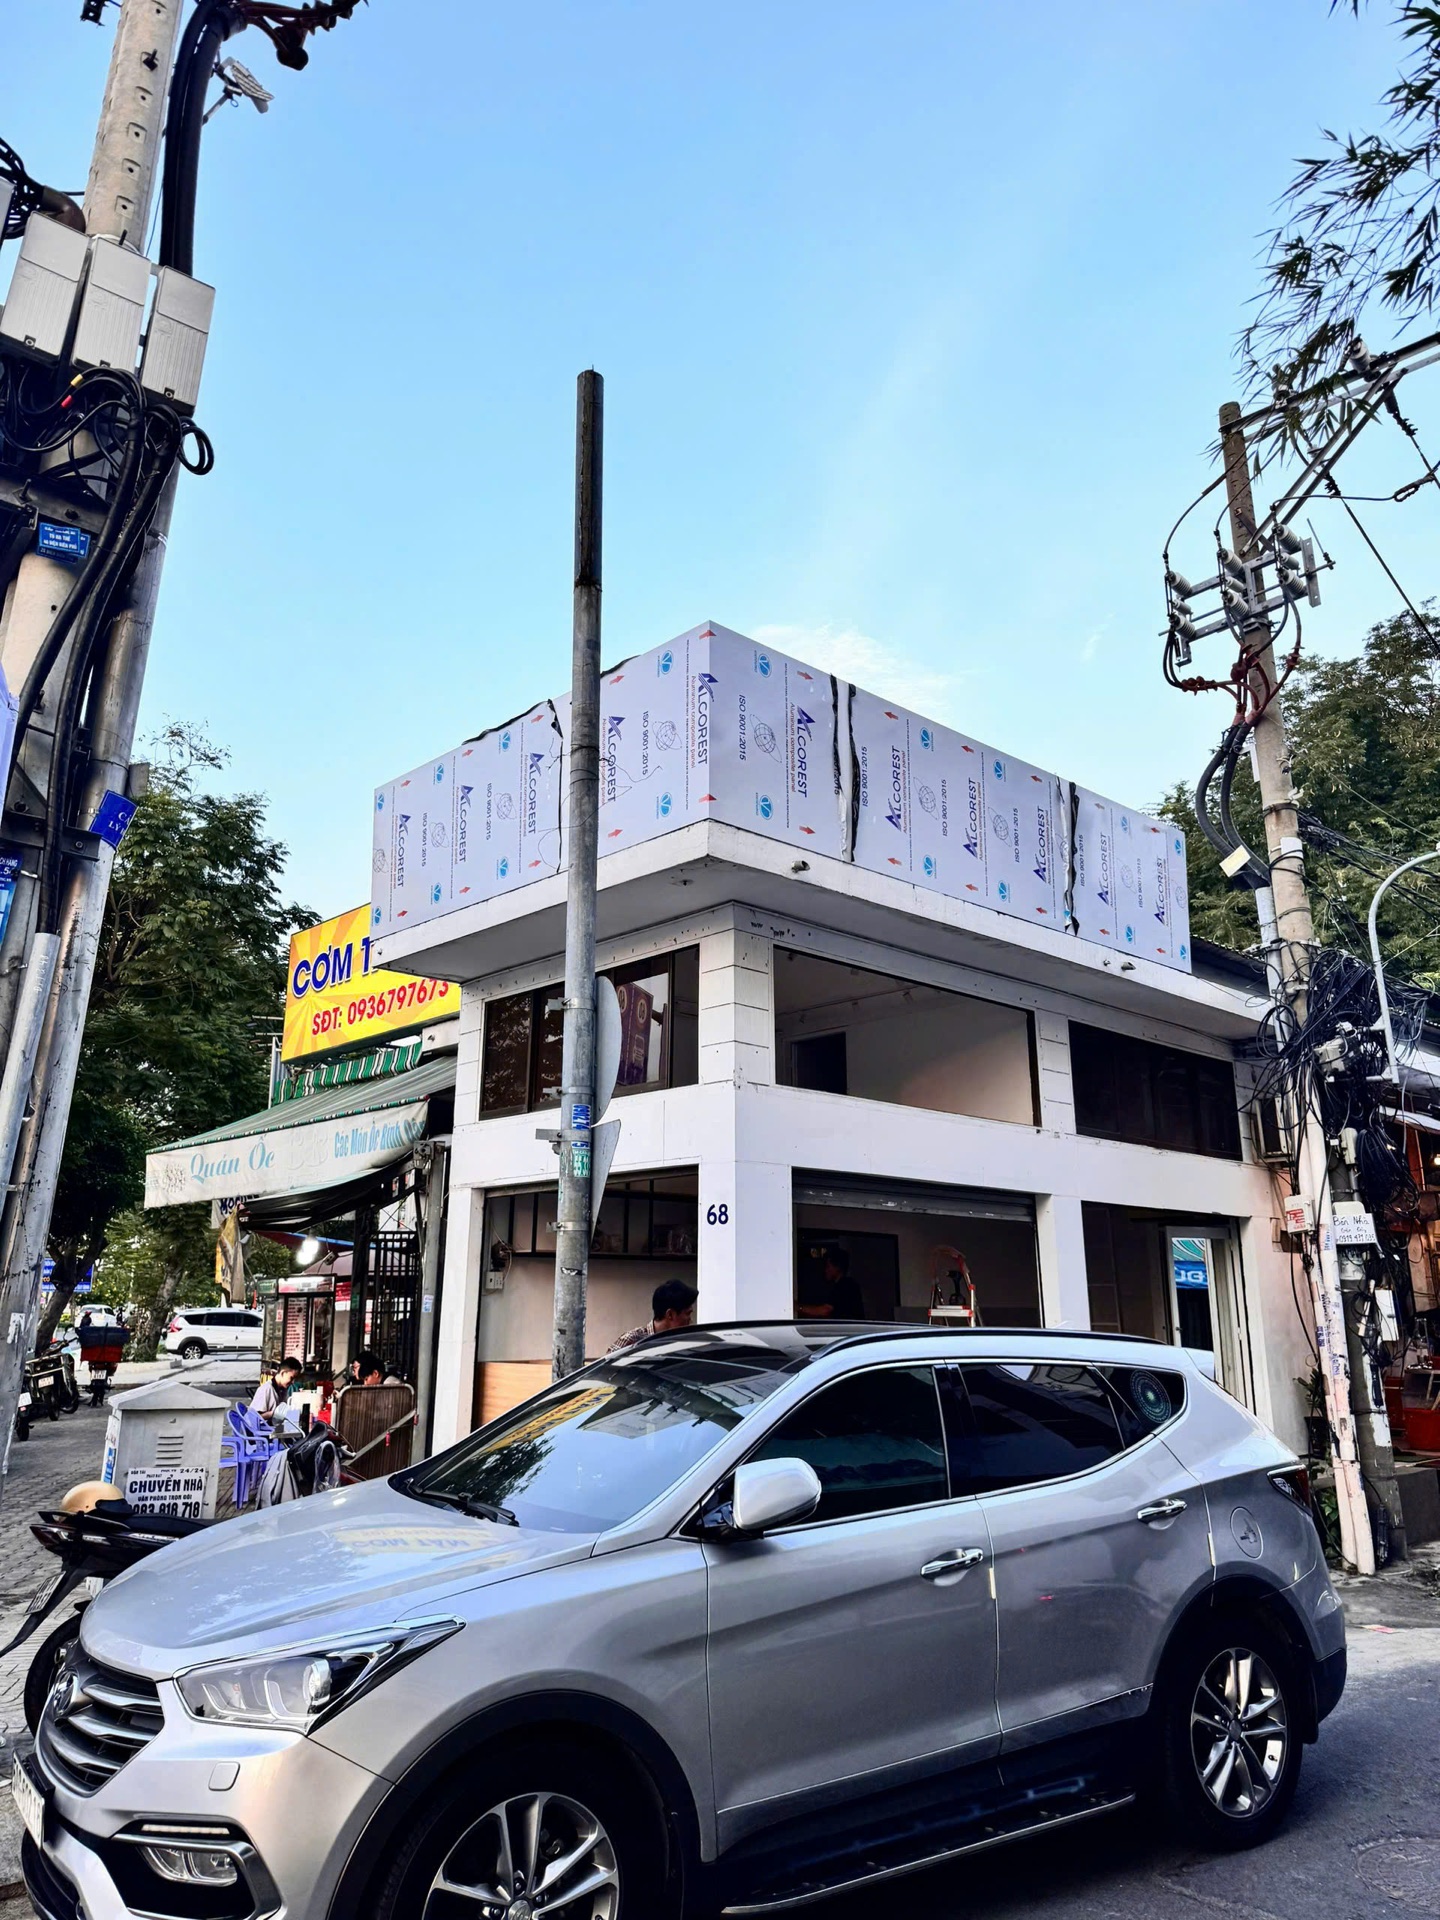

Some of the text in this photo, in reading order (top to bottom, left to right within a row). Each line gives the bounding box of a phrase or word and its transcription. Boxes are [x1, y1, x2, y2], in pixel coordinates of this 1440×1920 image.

[698, 672, 719, 764] ALCOREST
[738, 694, 746, 760] ISO 9001:2015
[797, 706, 816, 797] ALCOREST
[528, 752, 544, 834] ALCOREST
[607, 716, 626, 802] ALCOREST
[885, 745, 902, 832] ALCOREST
[397, 814, 411, 887] ALCOREST
[460, 785, 474, 862] ALCOREST
[963, 778, 978, 859] ALCOREST
[1033, 805, 1046, 884] ALCOREST
[1097, 832, 1108, 906] ALCOREST
[1154, 856, 1165, 926] ALCOREST
[293, 943, 353, 996] CƠM
[312, 1007, 342, 1036] SĐT:
[190, 1153, 240, 1184] Quán
[706, 1204, 729, 1225] 68
[129, 1474, 203, 1493] CHUYỂN NHÀ
[182, 1501, 200, 1518] 718
